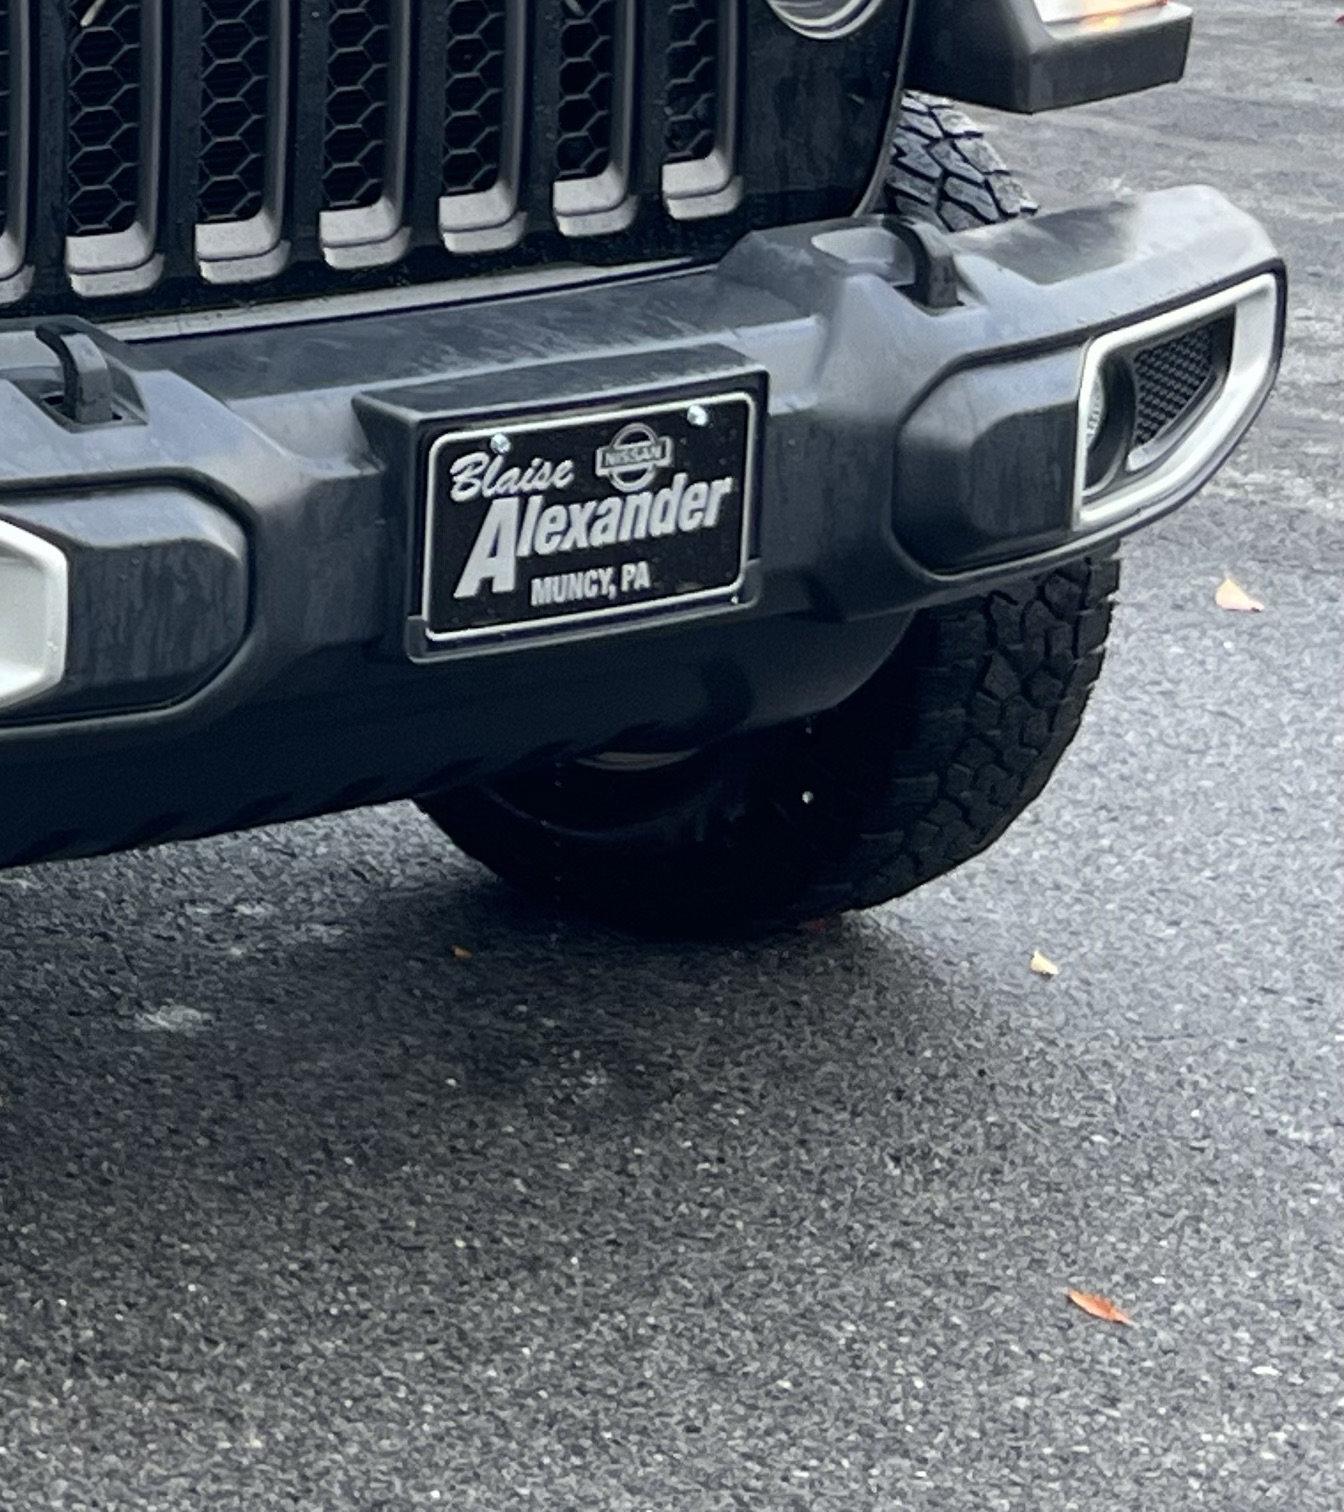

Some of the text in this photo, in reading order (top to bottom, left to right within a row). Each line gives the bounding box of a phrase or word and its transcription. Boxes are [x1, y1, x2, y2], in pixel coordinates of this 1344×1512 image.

[450, 451, 575, 502] Blaise
[604, 444, 662, 467] NISSAN
[454, 472, 734, 599] Alexander
[531, 560, 651, 607] MUNCY, PA
